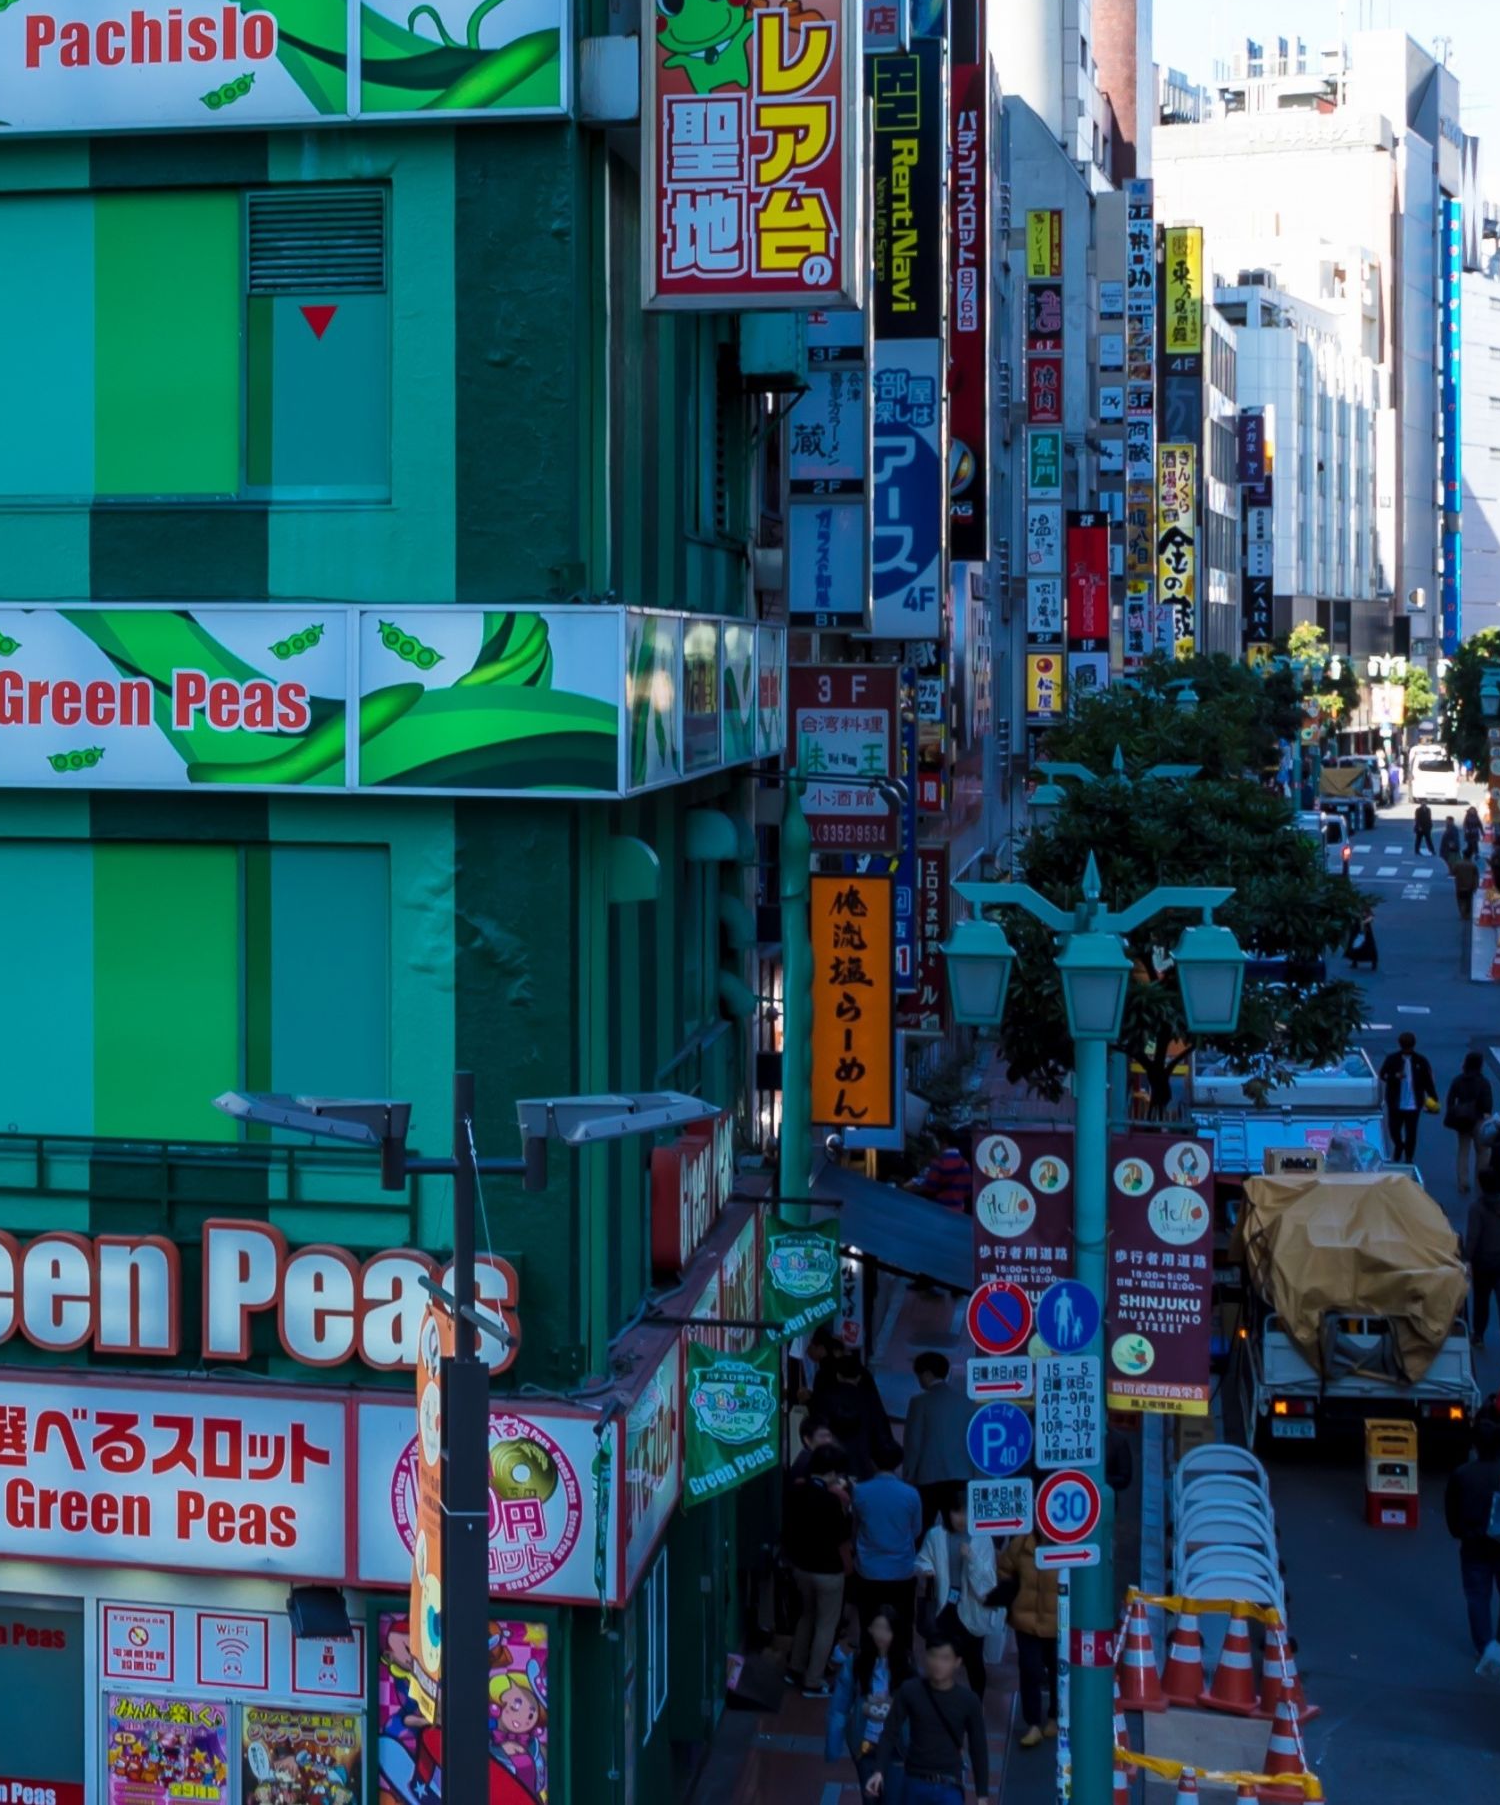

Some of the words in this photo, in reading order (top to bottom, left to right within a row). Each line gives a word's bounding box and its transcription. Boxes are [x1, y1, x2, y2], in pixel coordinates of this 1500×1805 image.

[25, 5, 276, 69] Pachislo
[758, 12, 832, 285] レア台の
[671, 100, 740, 270] 聖地
[893, 139, 919, 225] Rent
[957, 111, 978, 265] パチンコ・スロット
[1128, 206, 1150, 218] 7F
[892, 229, 917, 313] Navi
[813, 349, 841, 361] 3F
[1170, 357, 1196, 371] 4F
[1033, 366, 1056, 411] 焼肉
[1128, 394, 1150, 407] 5F
[791, 424, 828, 457] 蔵
[812, 481, 841, 493] 2F
[1176, 449, 1191, 515] きんくら
[873, 435, 918, 574] アース
[1158, 525, 1195, 638] 金の蔵
[902, 586, 936, 612] 4F
[1252, 581, 1267, 640] ZARA
[815, 613, 838, 626] B1
[1036, 634, 1052, 642] 2F
[1081, 640, 1094, 651] 1F
[172, 670, 310, 732] Peas
[1037, 677, 1053, 708] 松屋
[801, 716, 885, 734] 台湾料理
[829, 884, 873, 1121] 俺流塩らーめん
[979, 1246, 1068, 1262] 歩行者用道路
[1114, 1250, 1207, 1268] 歩行者用道路
[206, 1222, 515, 1368] Peas
[1119, 1294, 1201, 1313] SHINJUKU
[805, 1298, 837, 1325] Peas
[1118, 1310, 1201, 1325] MUSASHINO
[1136, 1322, 1183, 1334] STREET
[982, 1422, 1008, 1467] P
[689, 1457, 731, 1497] Green
[731, 1443, 775, 1480] Peas
[5, 1478, 153, 1539] Green
[175, 1483, 299, 1548] Peas
[1051, 1491, 1087, 1523] 30
[13, 1622, 67, 1650] Peas
[11, 1783, 56, 1804] Peas
